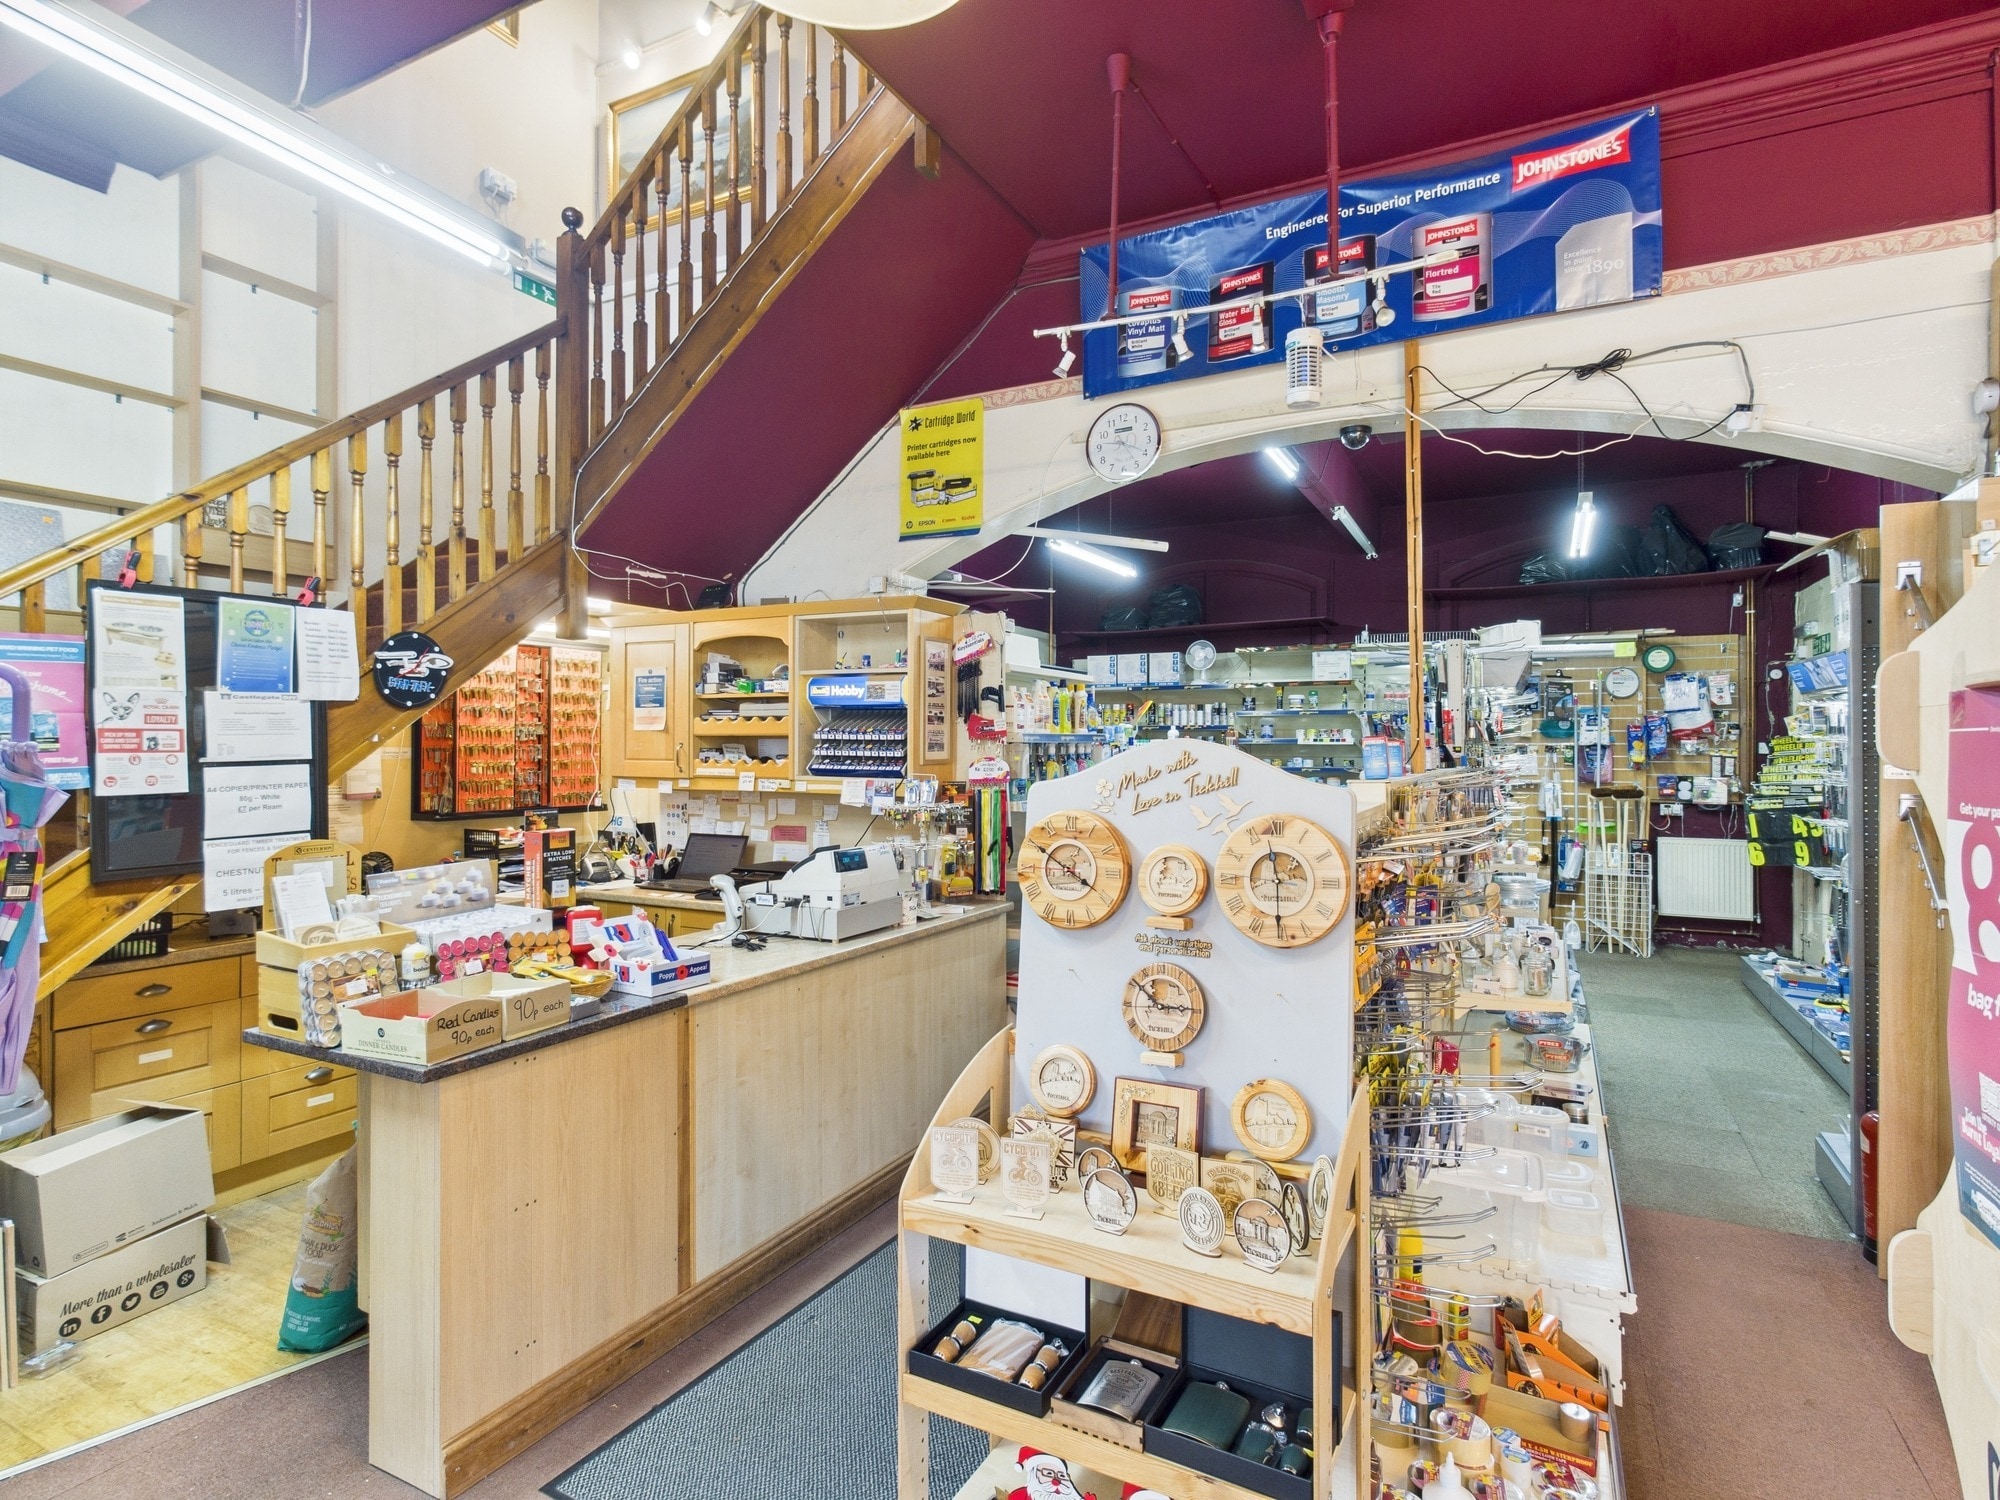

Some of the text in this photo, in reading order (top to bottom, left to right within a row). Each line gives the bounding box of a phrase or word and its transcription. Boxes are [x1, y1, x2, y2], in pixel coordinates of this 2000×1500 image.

[1516, 137, 1623, 183] JOHNSTONE'S
[1357, 195, 1411, 216] Superior
[1415, 173, 1500, 202] Performance
[1427, 224, 1475, 242] JOHNSTONE'S
[1563, 247, 1602, 260] Excellence
[1425, 265, 1459, 278] Flortred
[1585, 258, 1624, 275] 1890
[1221, 273, 1261, 291] JOHNSTONE'S
[1130, 293, 1169, 308] JOHNSTONE'S
[1317, 293, 1349, 304] Masonry
[1219, 310, 1238, 320] Water
[1219, 318, 1237, 327] Gloss
[1127, 324, 1165, 336] Vinyl Matt
[924, 410, 976, 428] Cartridge World
[1108, 419, 1115, 428] 11
[1119, 413, 1128, 422] 12
[1143, 422, 1149, 431] 2
[907, 443, 928, 452] Printer
[929, 437, 961, 449] cartridges
[1146, 435, 1151, 444] 3
[907, 449, 950, 461] available here
[1097, 444, 1102, 452] 9
[1100, 456, 1106, 464] 8
[1134, 460, 1139, 469] 5
[1109, 464, 1114, 472] 7
[830, 685, 865, 698] Hobby
[146, 715, 177, 723] LOYALTY
[1116, 749, 1198, 798] Made with
[219, 783, 283, 793] COPIER/PRINTER
[1132, 765, 1240, 815] Love in Tickhill
[1960, 802, 1990, 820] Get your
[611, 816, 623, 827] HG
[1791, 814, 1808, 838] 4
[1748, 842, 1765, 866] 6
[1794, 841, 1809, 866] 9
[230, 888, 253, 896] litres
[1135, 933, 1213, 950] Ask about variations
[1139, 944, 1211, 959] and personalisation
[659, 963, 708, 980] Poppy Appeal
[1967, 982, 1994, 1021] bag
[514, 997, 564, 1021] 90p each
[437, 1008, 499, 1031] Red Candles
[451, 1025, 495, 1045] 90p each
[358, 1040, 380, 1049] DINNER
[380, 1043, 408, 1053] CANDLES
[304, 1247, 324, 1259] FOOD
[320, 1242, 340, 1252] DUCK
[60, 1254, 196, 1318] More than a wholesaler
[1550, 1449, 1594, 1468] WATERPROOF
